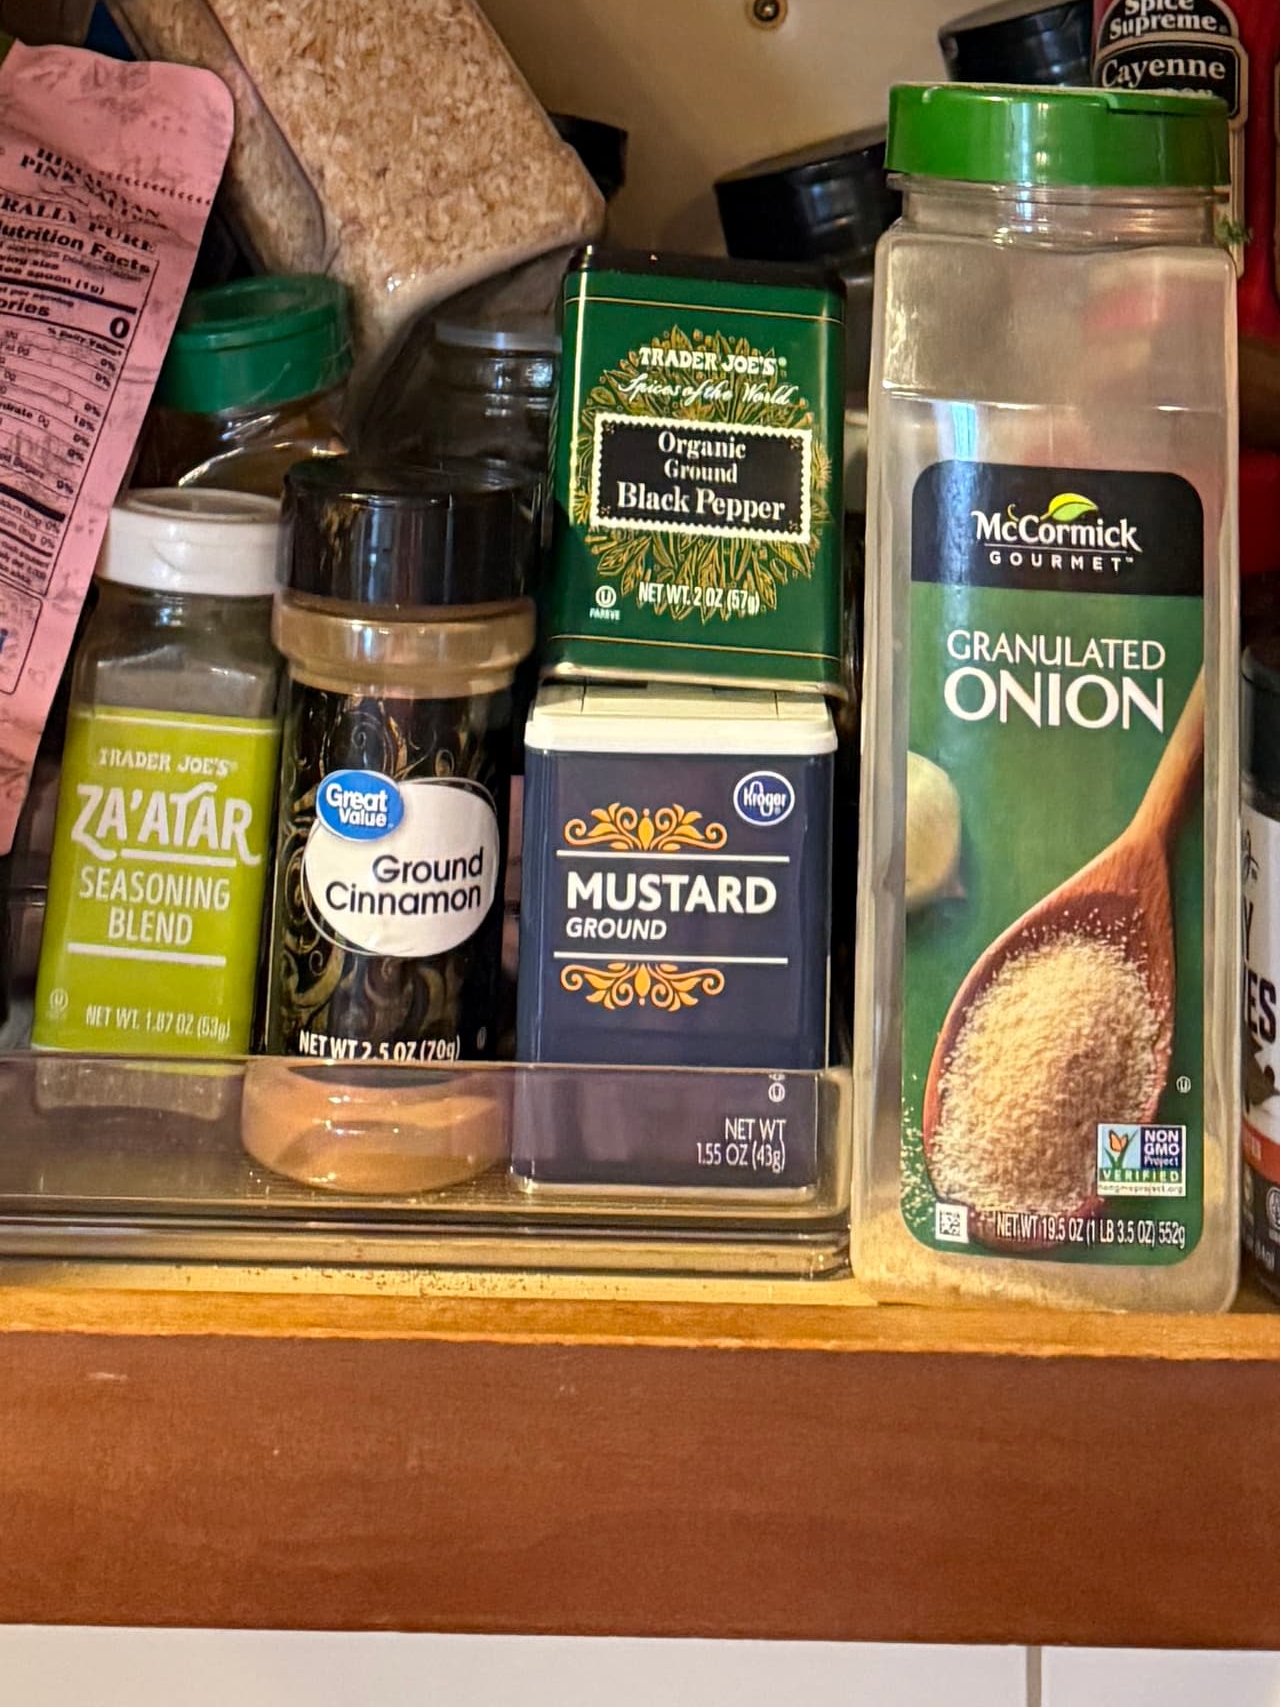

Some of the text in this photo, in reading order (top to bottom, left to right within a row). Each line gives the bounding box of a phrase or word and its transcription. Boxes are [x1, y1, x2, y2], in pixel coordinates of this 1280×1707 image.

[1110, 14, 1218, 40] Supreme
[1102, 58, 1226, 88] Cayenne
[88, 221, 155, 253] PURE
[90, 242, 150, 274] Facts
[110, 317, 130, 339] 0
[638, 347, 777, 376] TRADER JOE'S
[619, 373, 799, 406] Spices of the World
[658, 430, 746, 460] Organic
[664, 458, 738, 484] Ground
[617, 480, 786, 523] Black Pepper
[971, 504, 1143, 553] McCormick
[989, 551, 1125, 572] GOURMET
[638, 581, 760, 615] NET WT. 2 OZ (57g)
[947, 629, 1166, 671] GRANULATED
[943, 667, 1165, 735] ONION
[98, 748, 230, 777] TRADER JOE'S
[325, 783, 388, 811] Great
[743, 780, 789, 817] Kroger
[71, 781, 262, 867] ZA'ATAR
[338, 807, 388, 828] Value
[372, 847, 484, 885] Ground
[79, 865, 231, 912] SEASONING
[325, 881, 482, 916] Cinnamon
[566, 871, 778, 915] MUSTARD
[107, 906, 193, 946] BLEND
[566, 916, 667, 941] GROUND
[86, 1004, 231, 1041] NET WT. 1.87 OZ (53g)
[299, 1030, 461, 1062] NET WT 2.5 OZ (70g)
[725, 1118, 787, 1141] NET WT
[1145, 1130, 1179, 1143] NON
[696, 1141, 787, 1173] 1.55 OZ (43g)
[1144, 1144, 1180, 1156] GMO
[1144, 1157, 1179, 1168] Project
[1103, 1170, 1179, 1182] VERIFIED
[997, 1212, 1185, 1249] NET WT 19.5 OZ (1 LB 3.5 OZ) 552g
